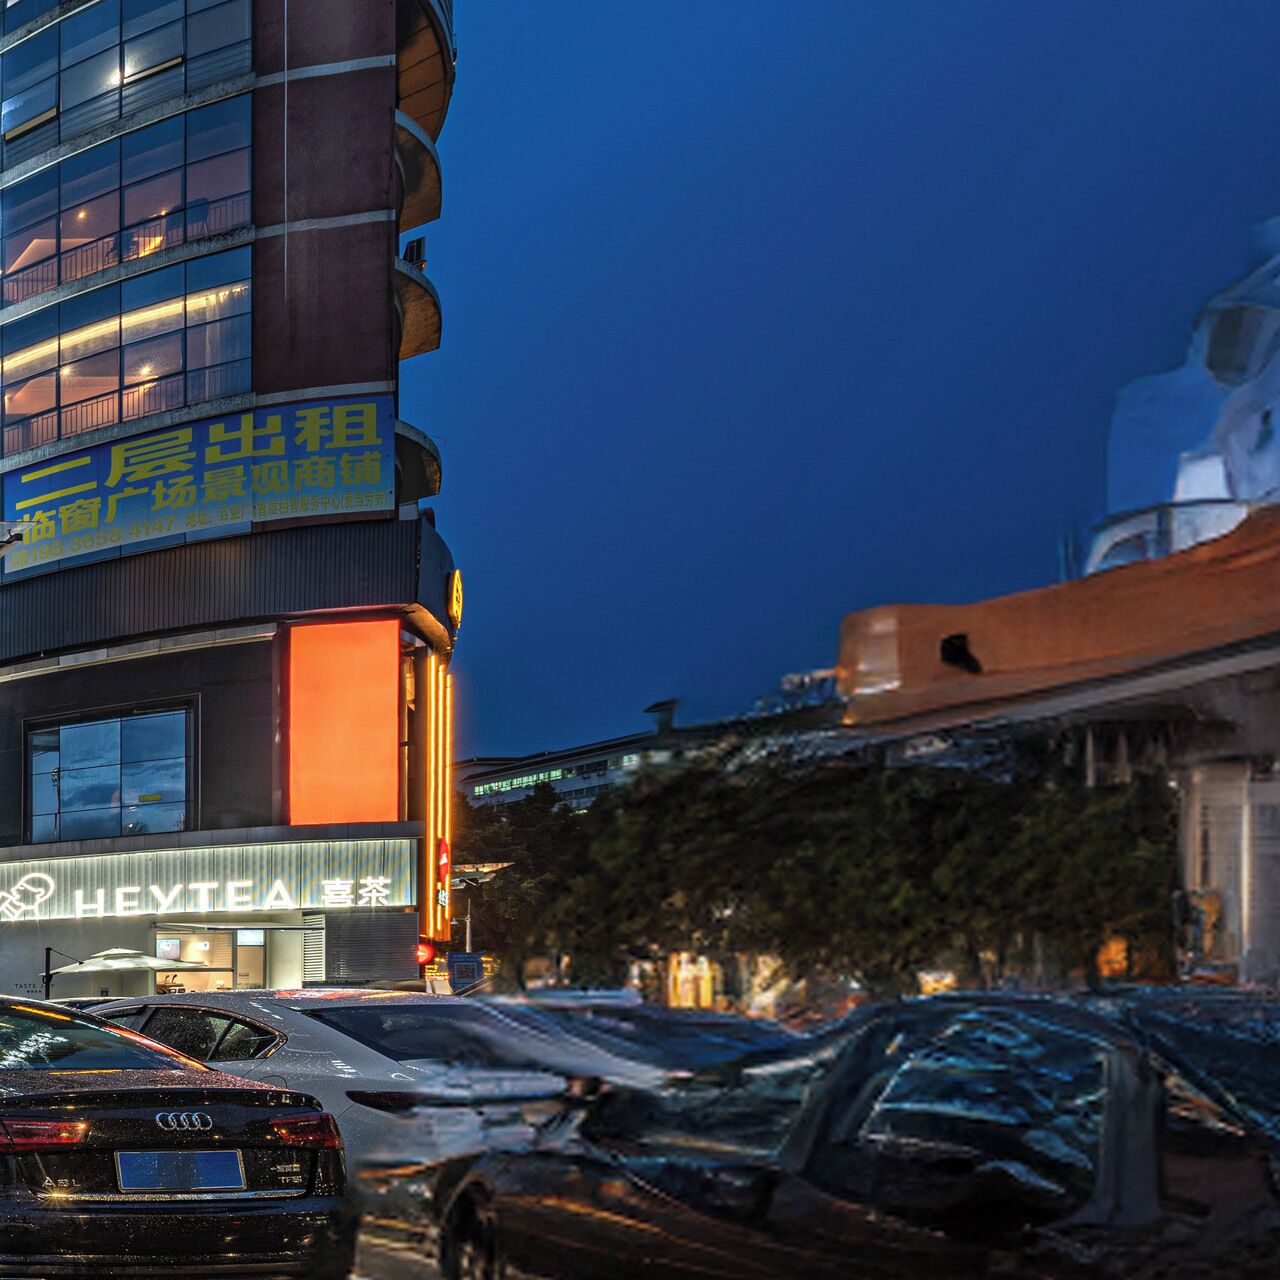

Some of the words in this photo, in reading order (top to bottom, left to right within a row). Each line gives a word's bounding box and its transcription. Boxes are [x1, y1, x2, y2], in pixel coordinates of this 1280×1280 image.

[15, 402, 382, 510] 二层出租
[17, 452, 381, 545] 临窗广场景观商铺
[70, 527, 122, 552] 3658
[128, 515, 177, 538] 4147
[74, 879, 297, 918] HEYTEA
[322, 876, 391, 908] 喜茶
